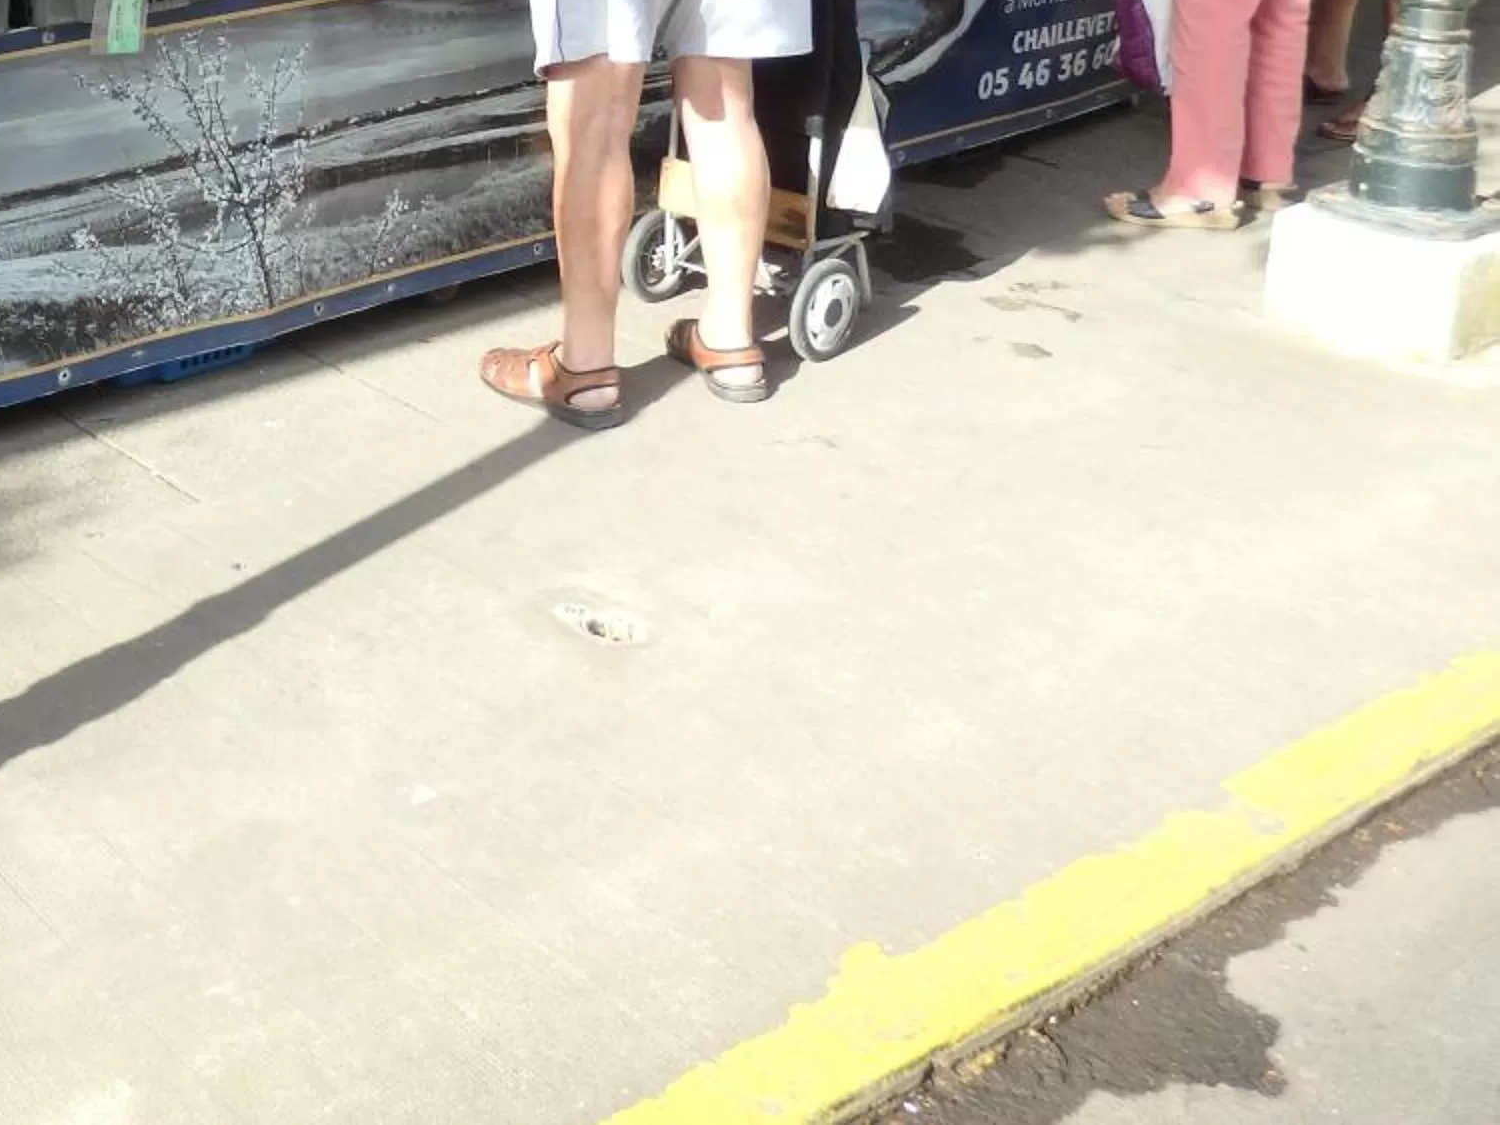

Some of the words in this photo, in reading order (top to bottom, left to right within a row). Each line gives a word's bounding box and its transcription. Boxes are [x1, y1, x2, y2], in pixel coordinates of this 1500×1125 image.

[977, 66, 1010, 101] 05
[1017, 57, 1051, 90] 46
[1057, 48, 1088, 81] 36
